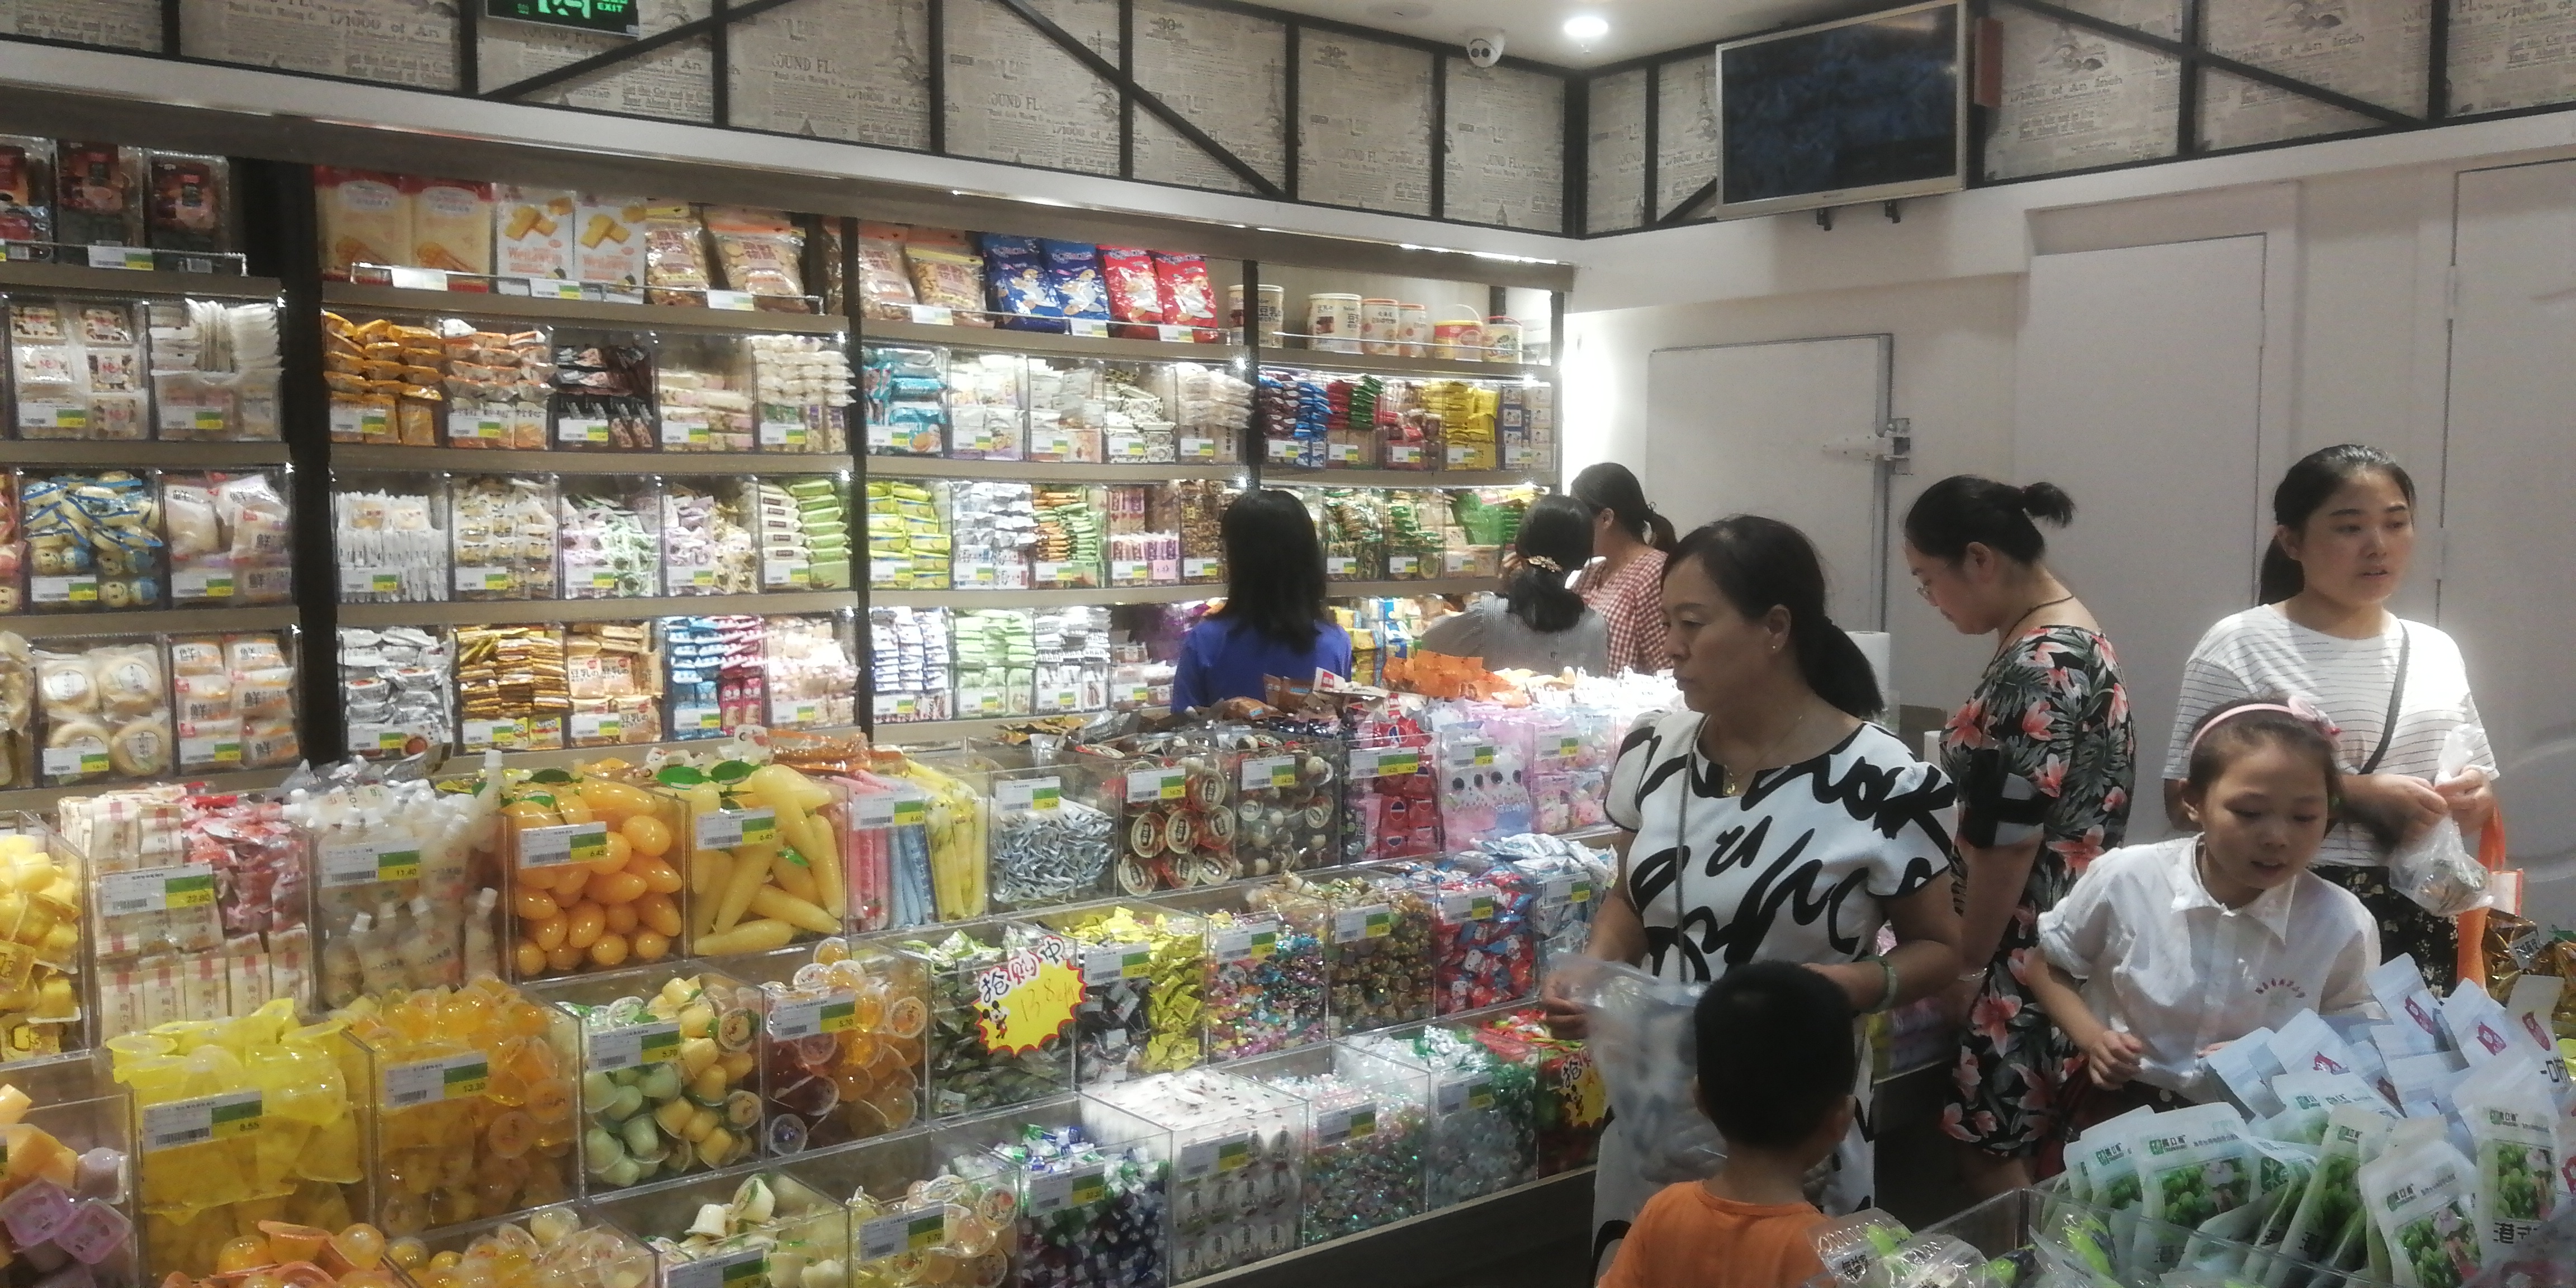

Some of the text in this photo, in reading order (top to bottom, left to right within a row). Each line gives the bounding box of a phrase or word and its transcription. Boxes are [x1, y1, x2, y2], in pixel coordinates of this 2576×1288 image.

[597, 3, 623, 12] EXIT
[396, 868, 416, 876] 11.40
[662, 1049, 678, 1058] 5.70
